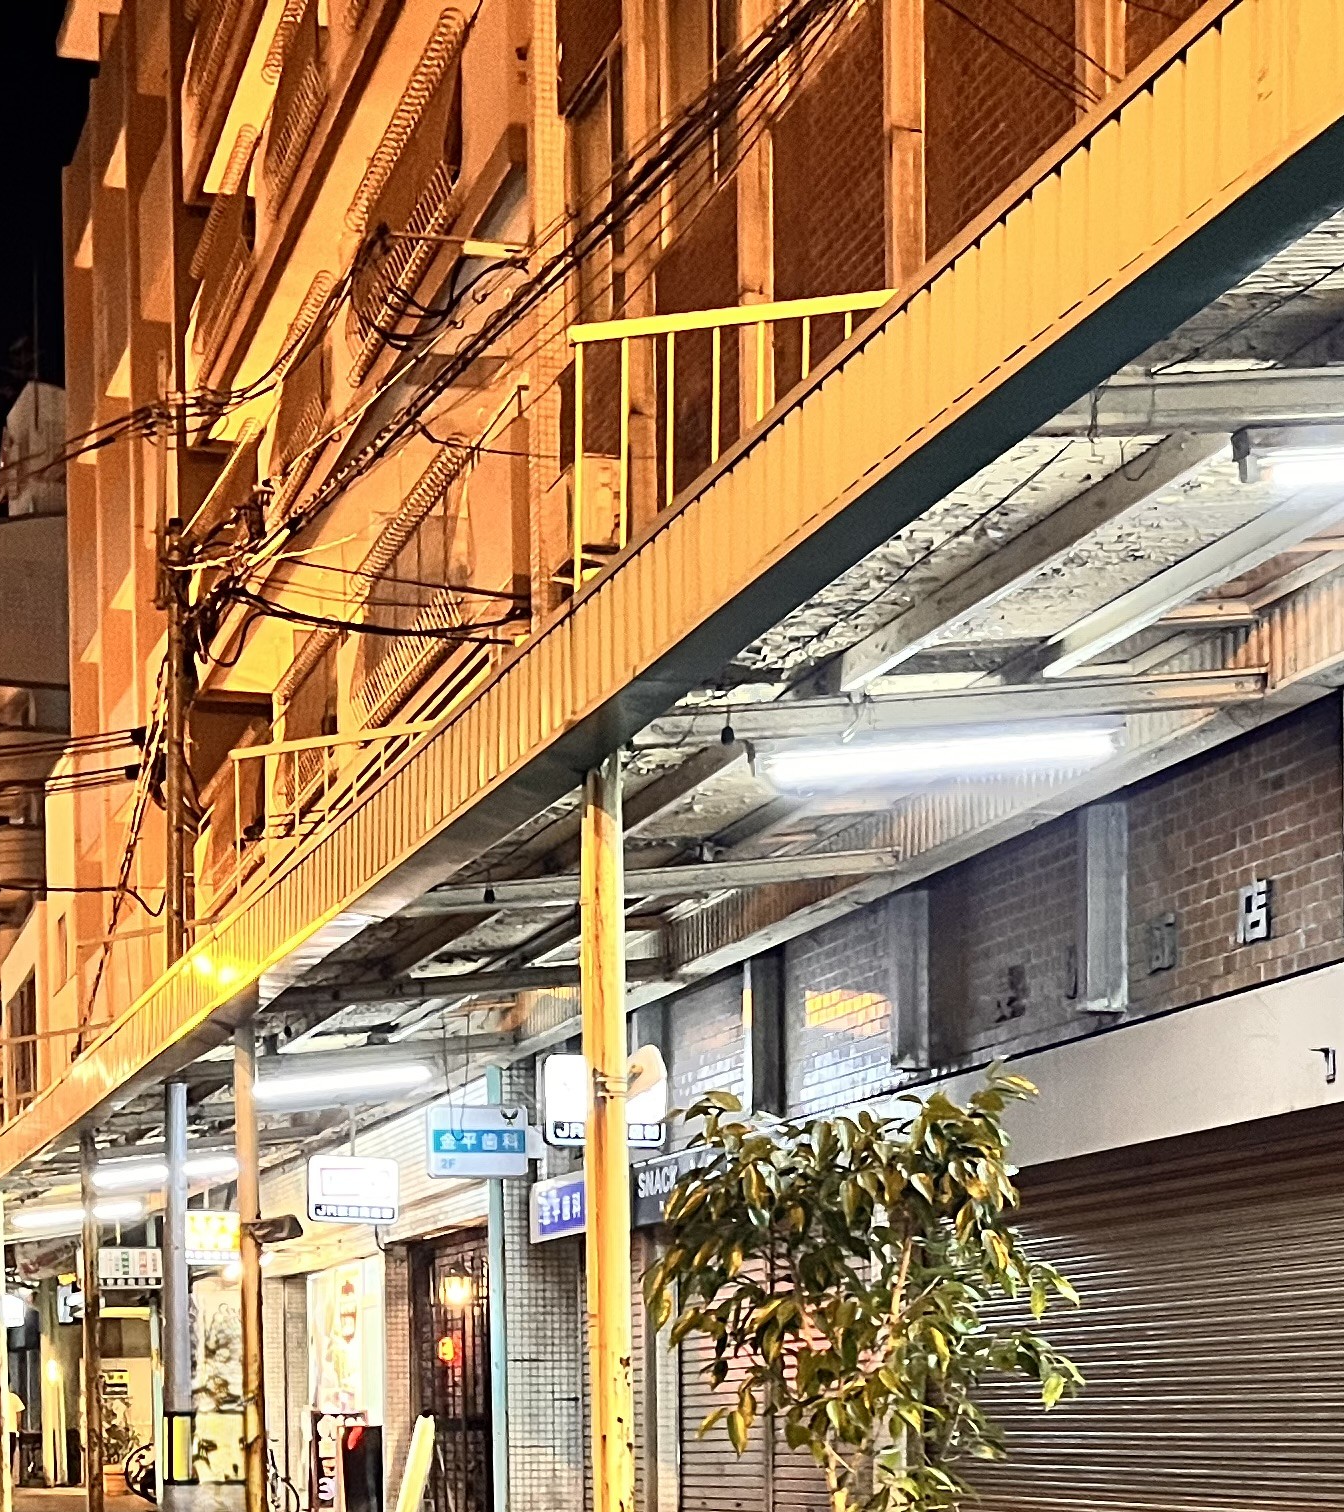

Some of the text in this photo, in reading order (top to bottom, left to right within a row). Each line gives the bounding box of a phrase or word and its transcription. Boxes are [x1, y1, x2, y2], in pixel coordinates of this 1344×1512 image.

[1236, 879, 1269, 943] 店
[439, 1132, 519, 1151] 金平歯科
[441, 1158, 457, 1170] 2F
[638, 1165, 677, 1198] SNACK
